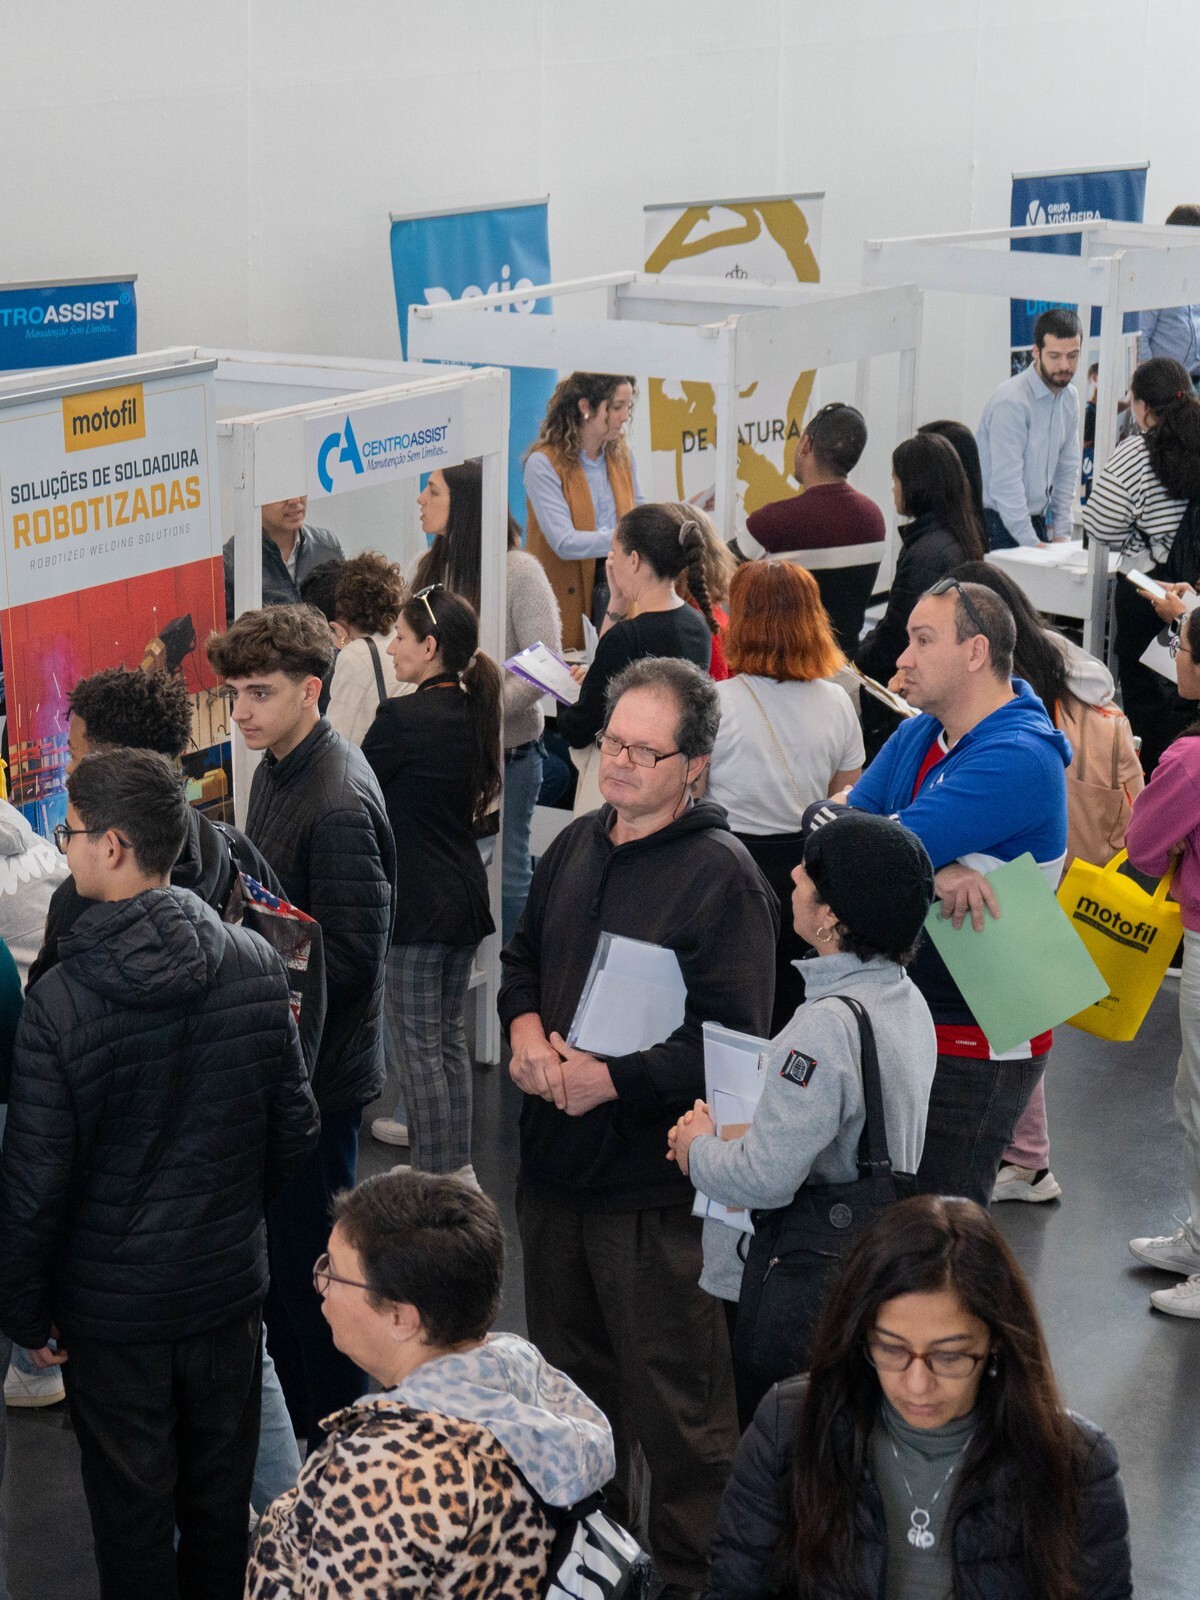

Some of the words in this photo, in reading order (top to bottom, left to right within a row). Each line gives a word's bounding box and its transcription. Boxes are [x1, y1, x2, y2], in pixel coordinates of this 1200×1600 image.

[1048, 202, 1070, 214] GRUPO
[25, 328, 68, 340] Manutenção
[70, 325, 85, 336] Sem
[72, 398, 137, 436] motofil
[362, 425, 448, 458] CENTROASSIST
[682, 428, 708, 453] DE
[715, 419, 801, 452] ATURA
[11, 470, 88, 505] SOLUÇÕES
[92, 466, 111, 487] DE
[115, 448, 199, 482] SOLDADURA
[366, 455, 406, 471] Manutenção
[407, 450, 421, 463] Sem
[12, 475, 202, 550] ROBOTIZADAS
[30, 547, 85, 571] ROBOTIZED
[89, 536, 134, 557] WELDING
[138, 523, 191, 545] SOLUTIONS
[1077, 896, 1158, 945] motofil
